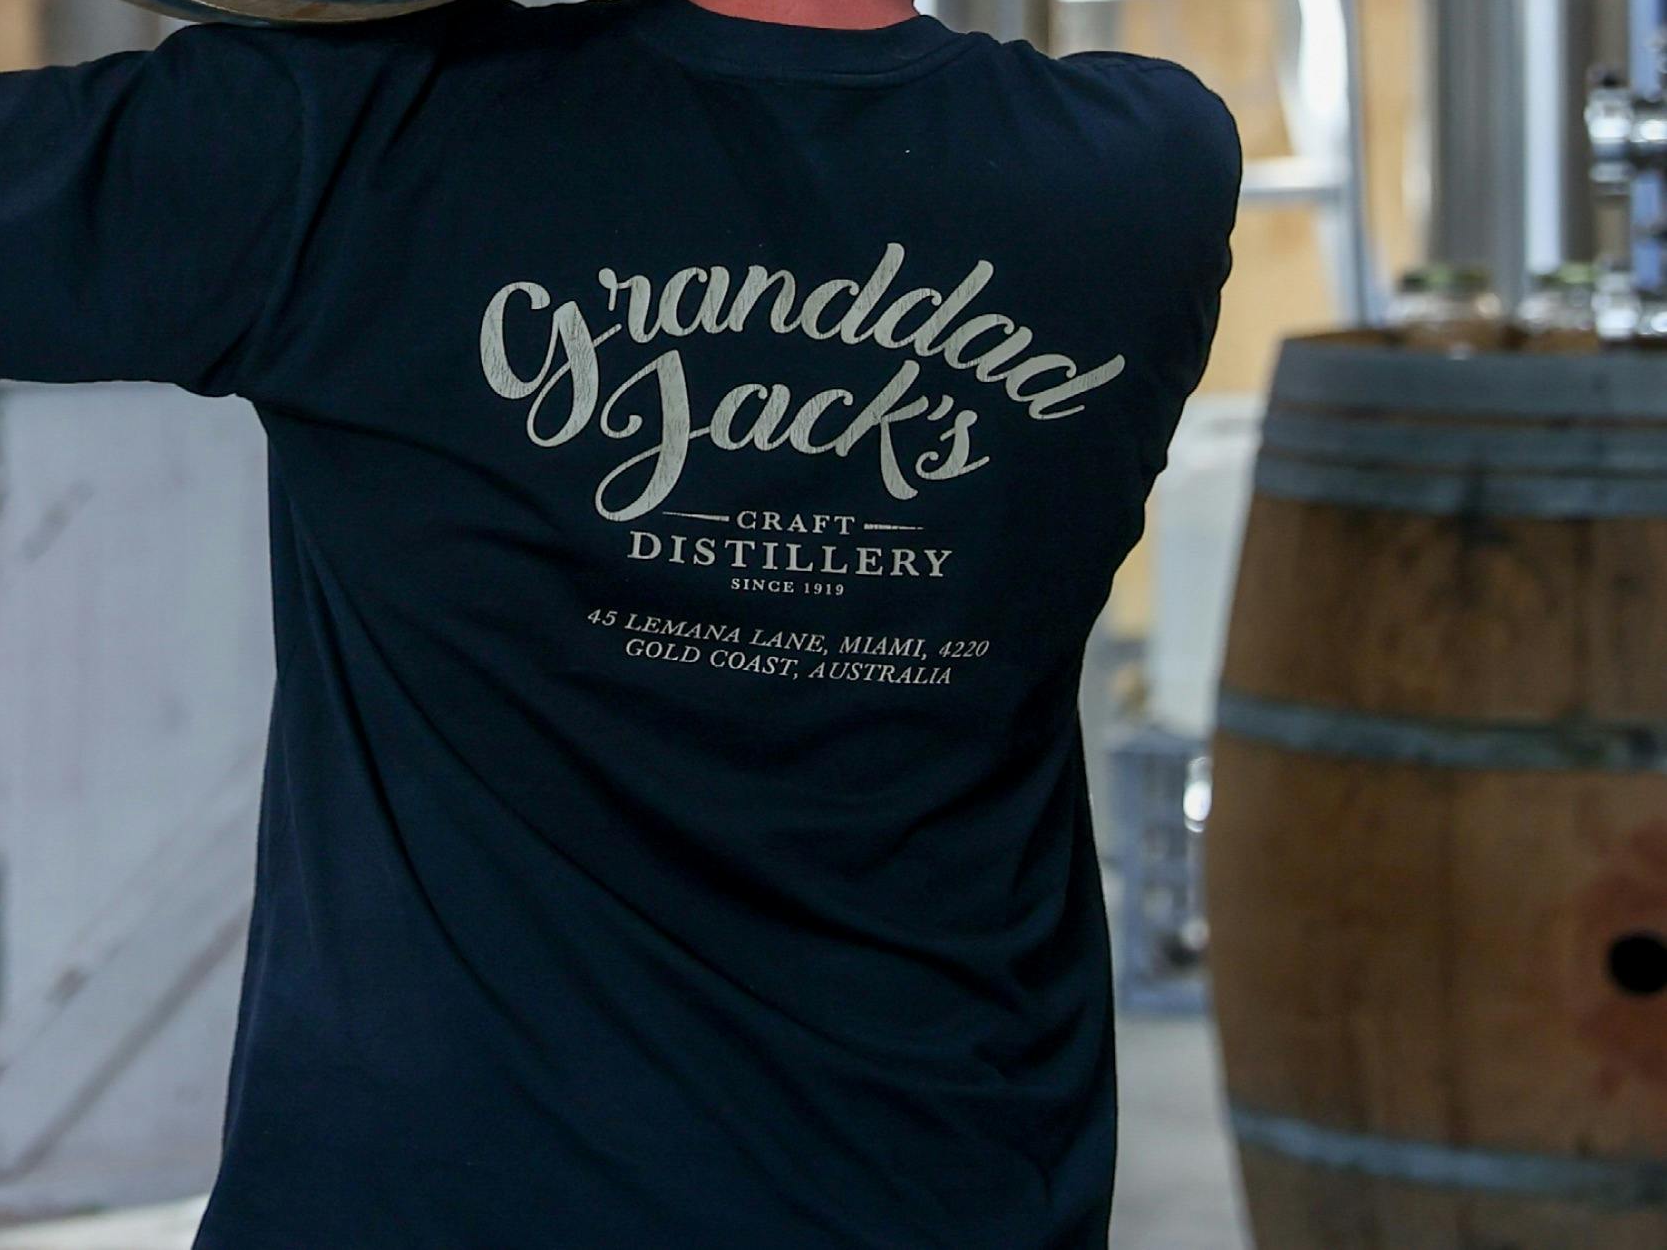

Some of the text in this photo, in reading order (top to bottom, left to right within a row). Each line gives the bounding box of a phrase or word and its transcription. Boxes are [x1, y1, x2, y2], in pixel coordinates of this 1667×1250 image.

[480, 243, 1125, 447] Granddad
[595, 350, 990, 521] Jack's
[736, 510, 855, 535] CRAFT
[627, 531, 952, 577] DISTILLERY
[731, 578, 844, 596] SINCE 1919
[587, 608, 989, 661] 45 LEMANA LANE, MIAMI, 4220
[625, 638, 951, 684] GOLD COAST, AUSTRALIA
